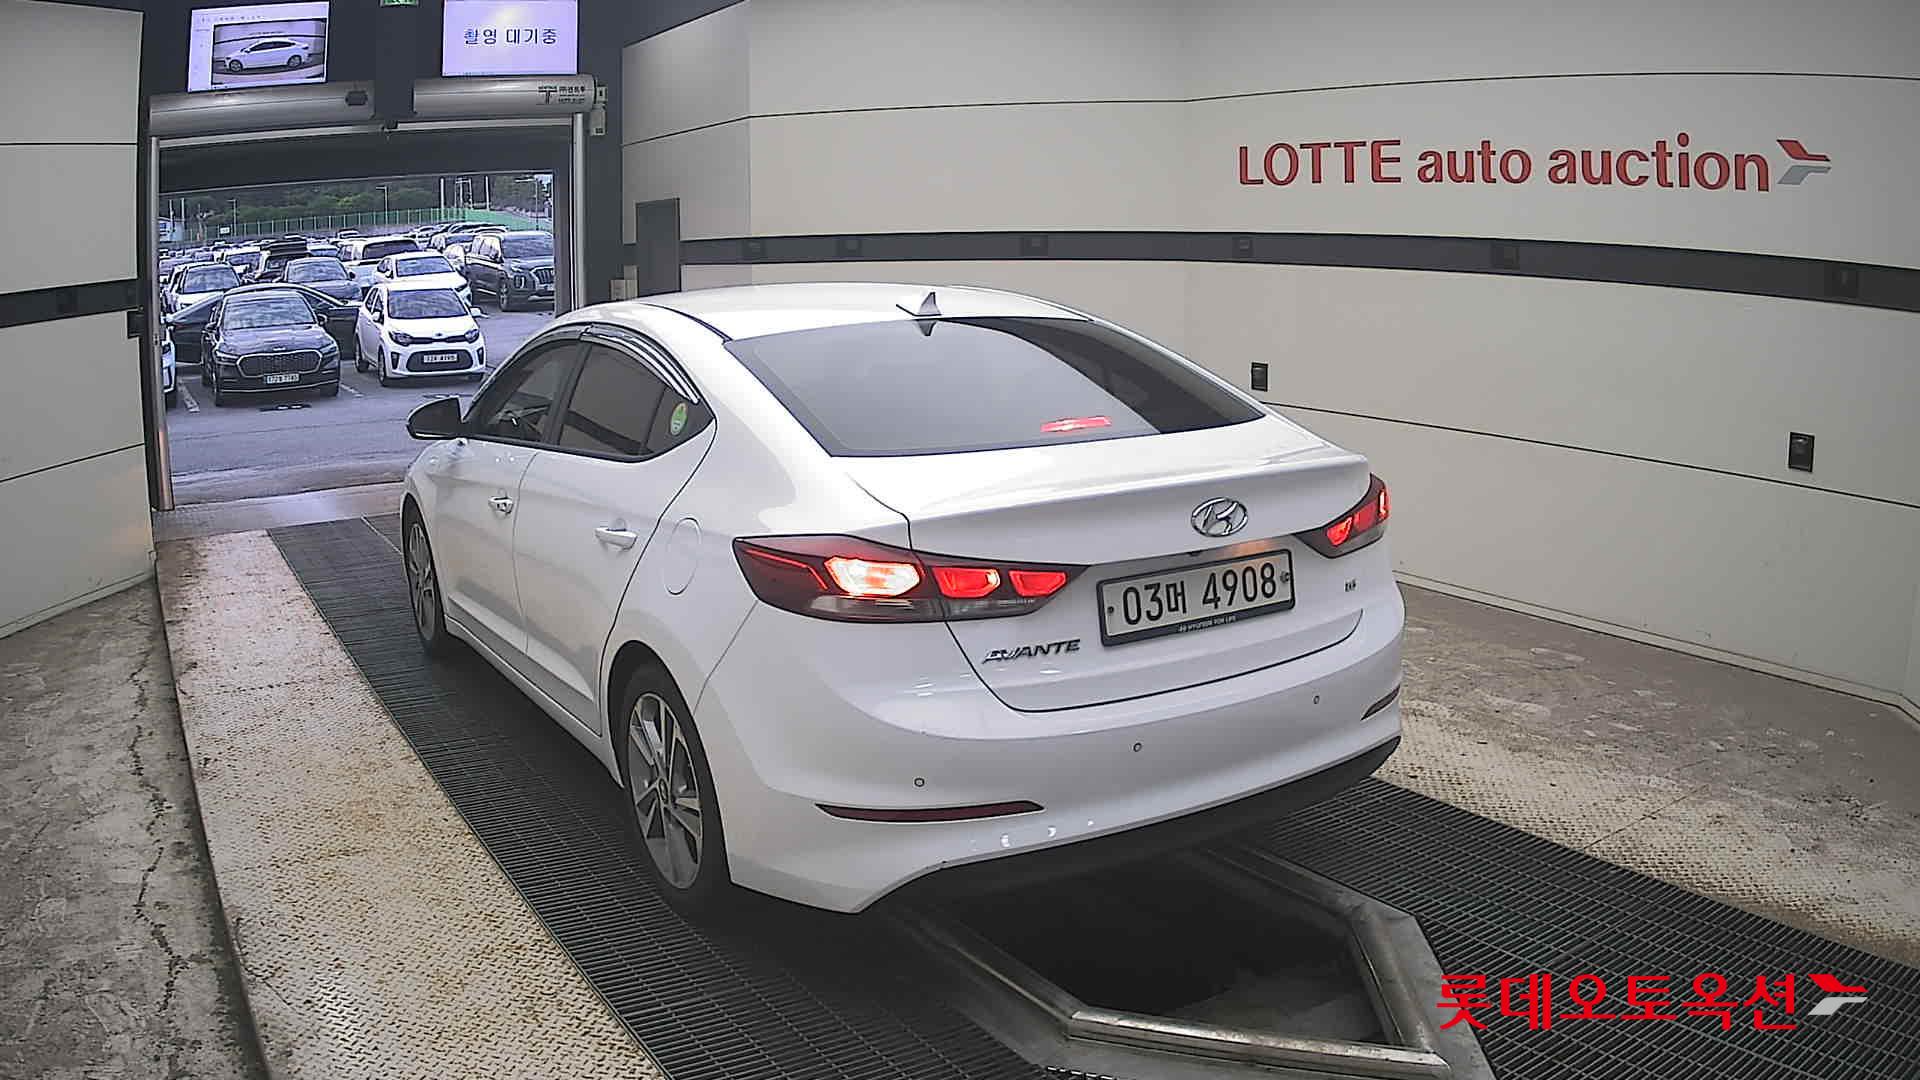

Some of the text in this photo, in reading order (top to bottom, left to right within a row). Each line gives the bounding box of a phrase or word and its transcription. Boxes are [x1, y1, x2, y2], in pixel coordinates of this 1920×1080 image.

[505, 28, 557, 45] 대기중
[1239, 132, 1770, 193] LOTTE auto auction
[1122, 562, 1277, 626] 03머 4908
[982, 638, 1081, 664] AVANTE
